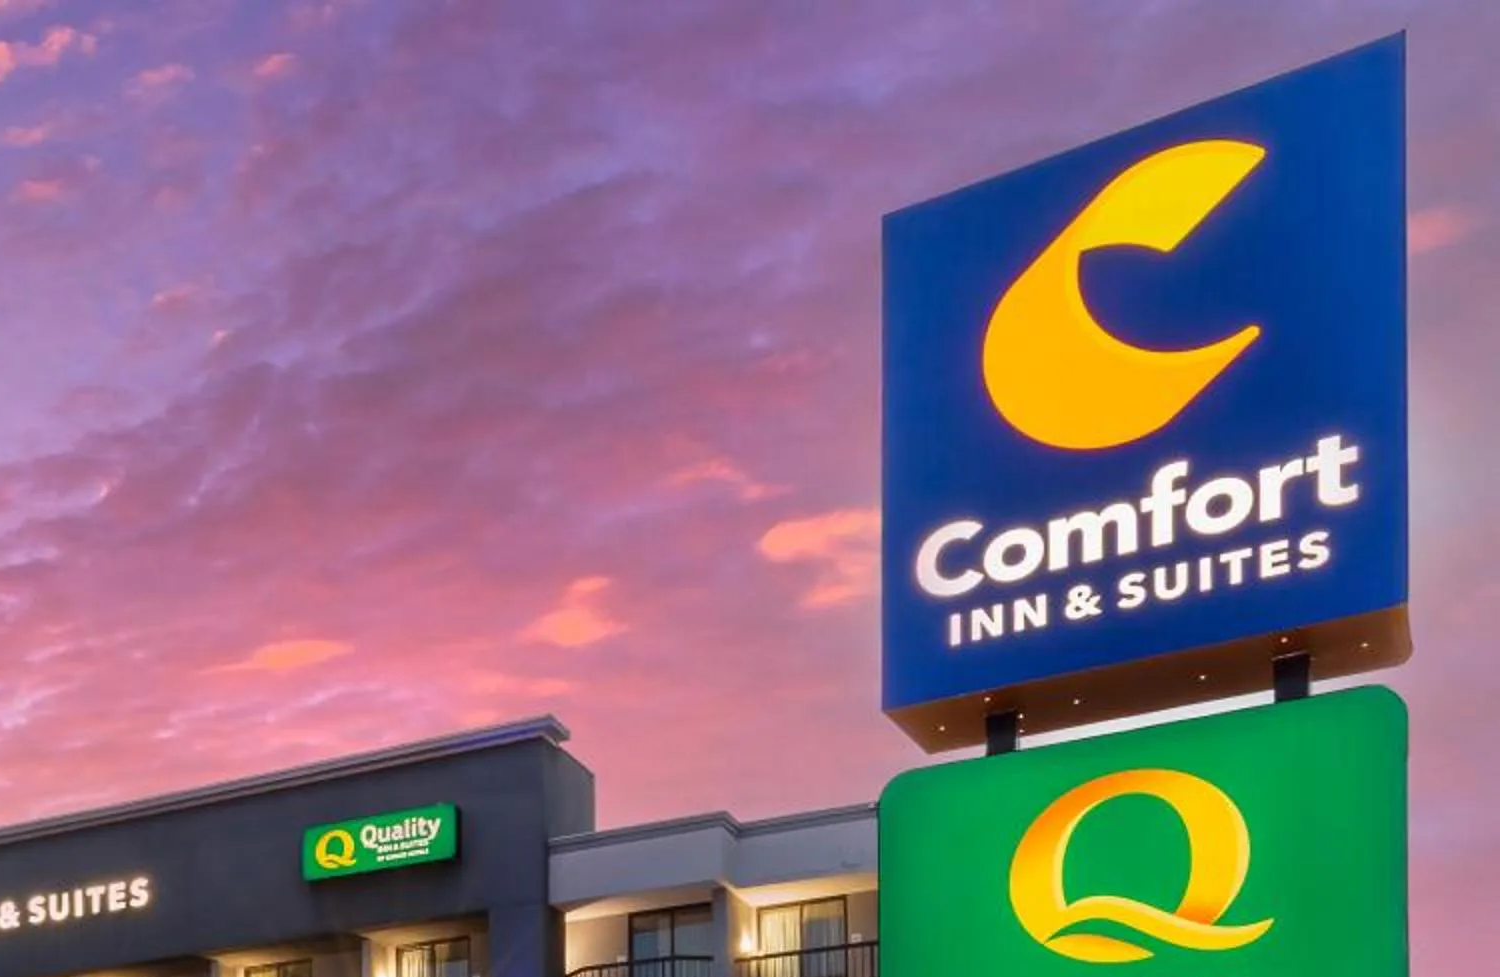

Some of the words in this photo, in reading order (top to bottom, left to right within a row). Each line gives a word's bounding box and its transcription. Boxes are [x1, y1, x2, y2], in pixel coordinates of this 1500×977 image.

[915, 434, 1359, 598] Comfort
[949, 594, 1047, 646] INN
[1065, 585, 1102, 621] &
[1117, 531, 1330, 609] SUITES
[315, 829, 357, 870] Q
[360, 816, 441, 849] Quality
[1009, 767, 1275, 963] Q
[28, 877, 150, 924] SUITES
